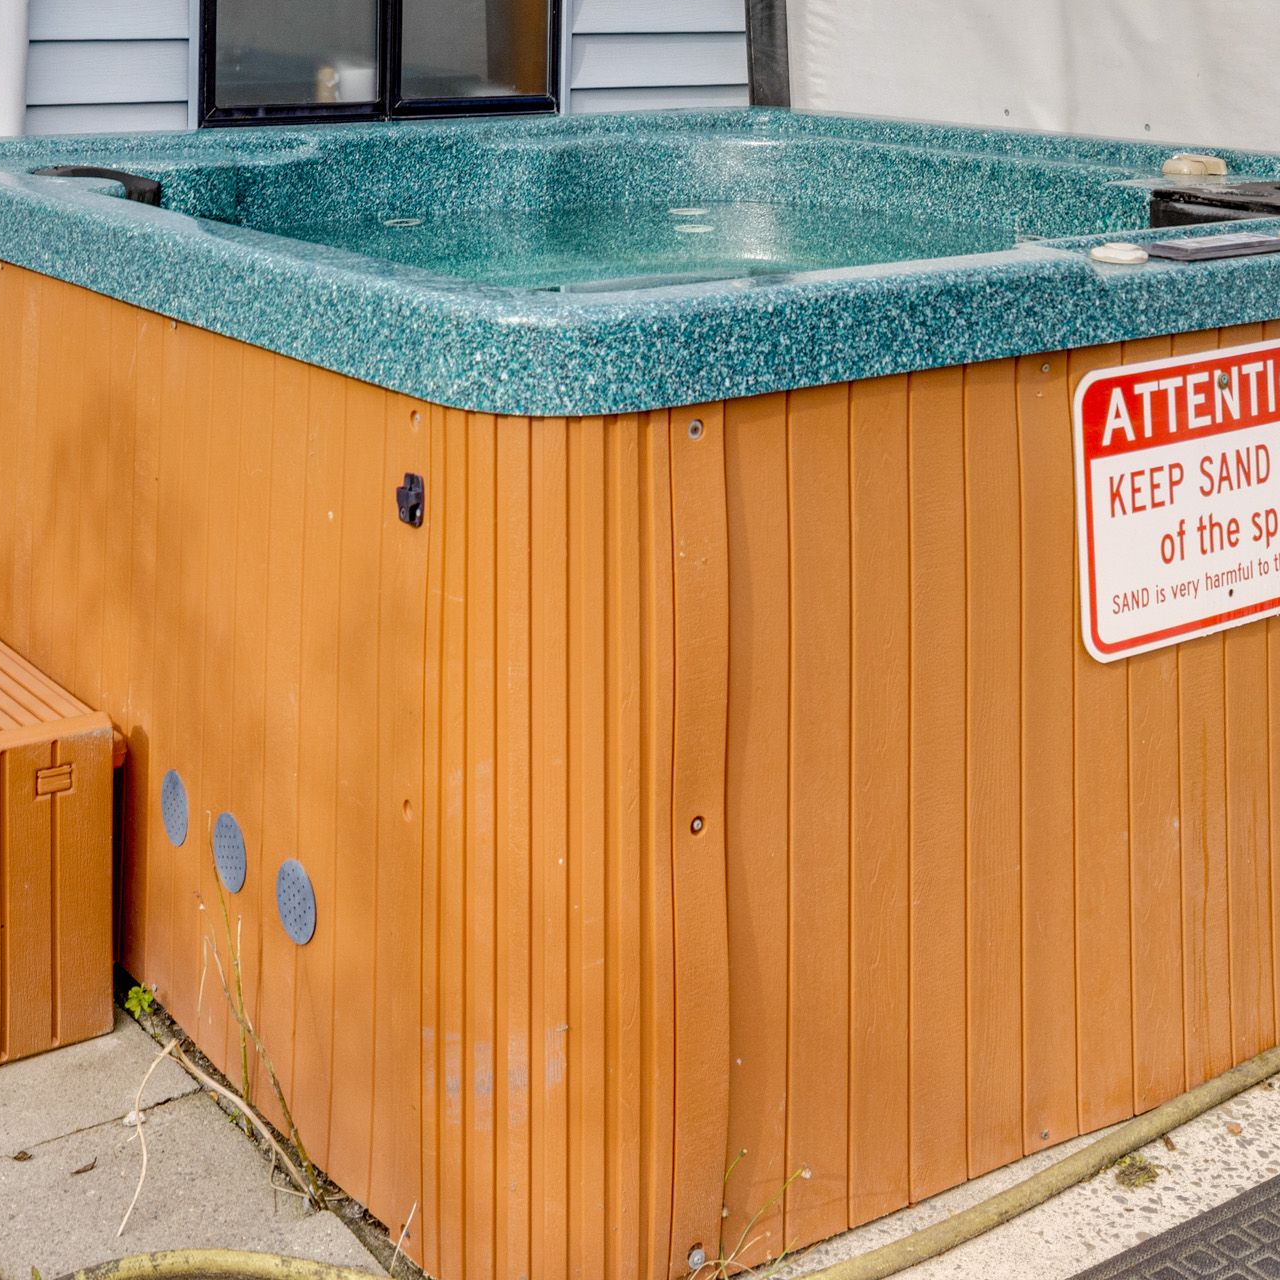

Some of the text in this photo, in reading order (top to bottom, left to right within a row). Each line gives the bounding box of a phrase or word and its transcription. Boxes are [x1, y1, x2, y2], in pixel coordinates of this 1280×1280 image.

[1109, 462, 1185, 518] KEEP
[1199, 443, 1270, 497] SAND
[1160, 518, 1186, 565] of
[1197, 512, 1240, 555] the
[1112, 587, 1150, 615] SAND
[1155, 584, 1166, 605] is
[1171, 577, 1200, 602] very
[1205, 560, 1254, 592] harmful
[1258, 557, 1270, 576] to
